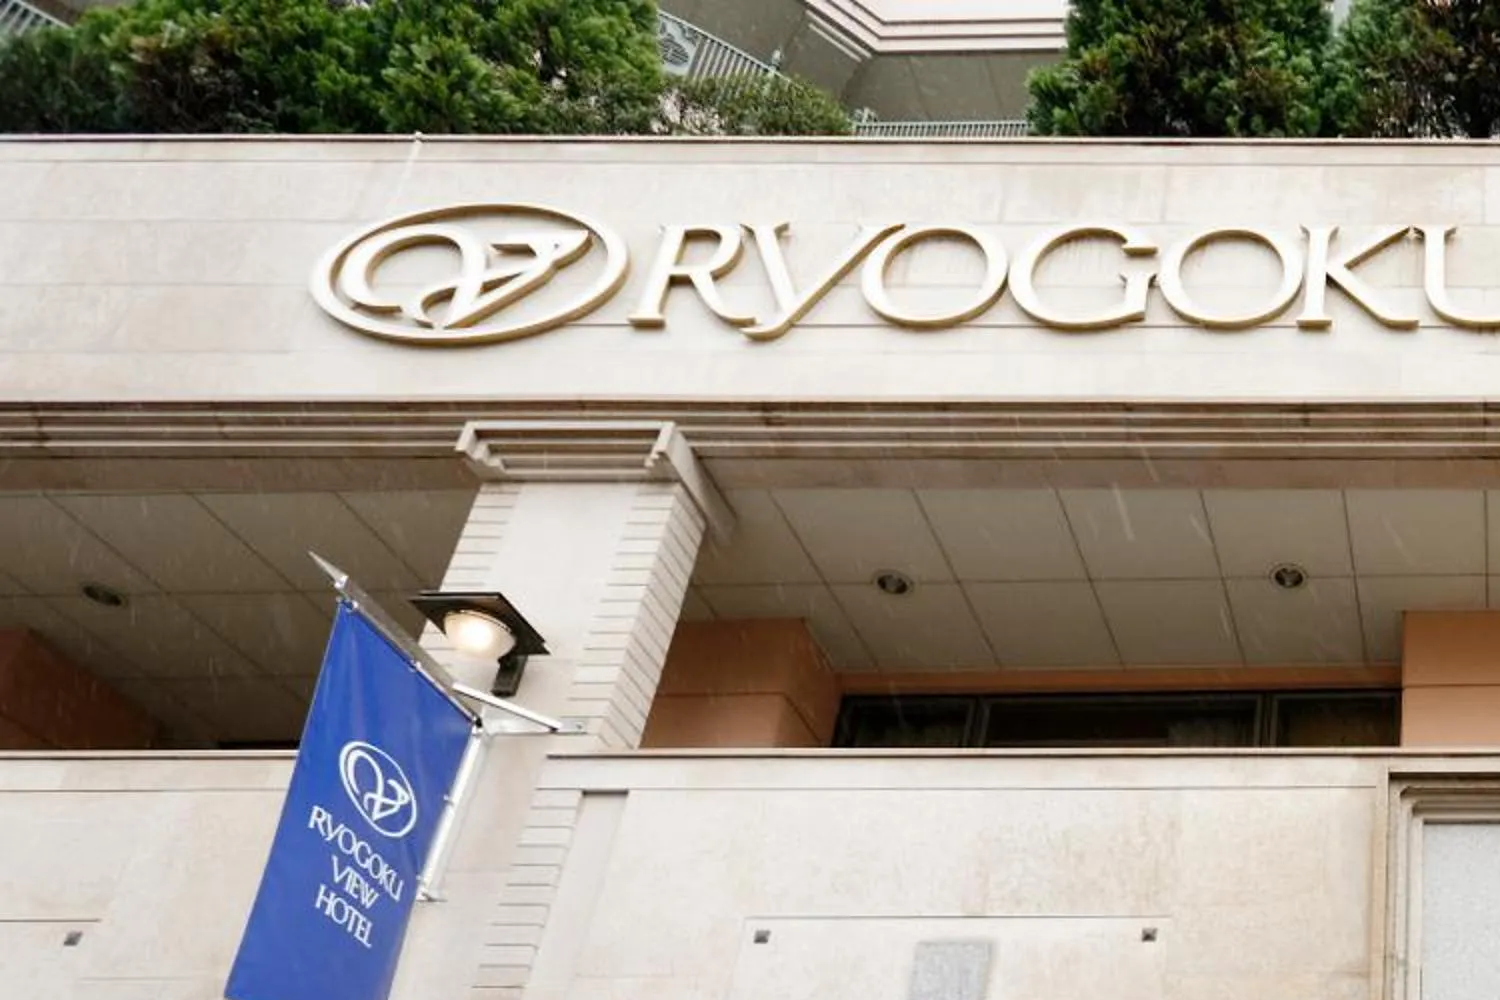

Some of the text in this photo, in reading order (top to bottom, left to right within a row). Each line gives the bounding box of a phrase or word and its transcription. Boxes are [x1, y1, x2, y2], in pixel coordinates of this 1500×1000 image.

[308, 805, 405, 902] RYOGOKU
[331, 855, 379, 909] VIEW
[314, 884, 373, 948] HOTEL
